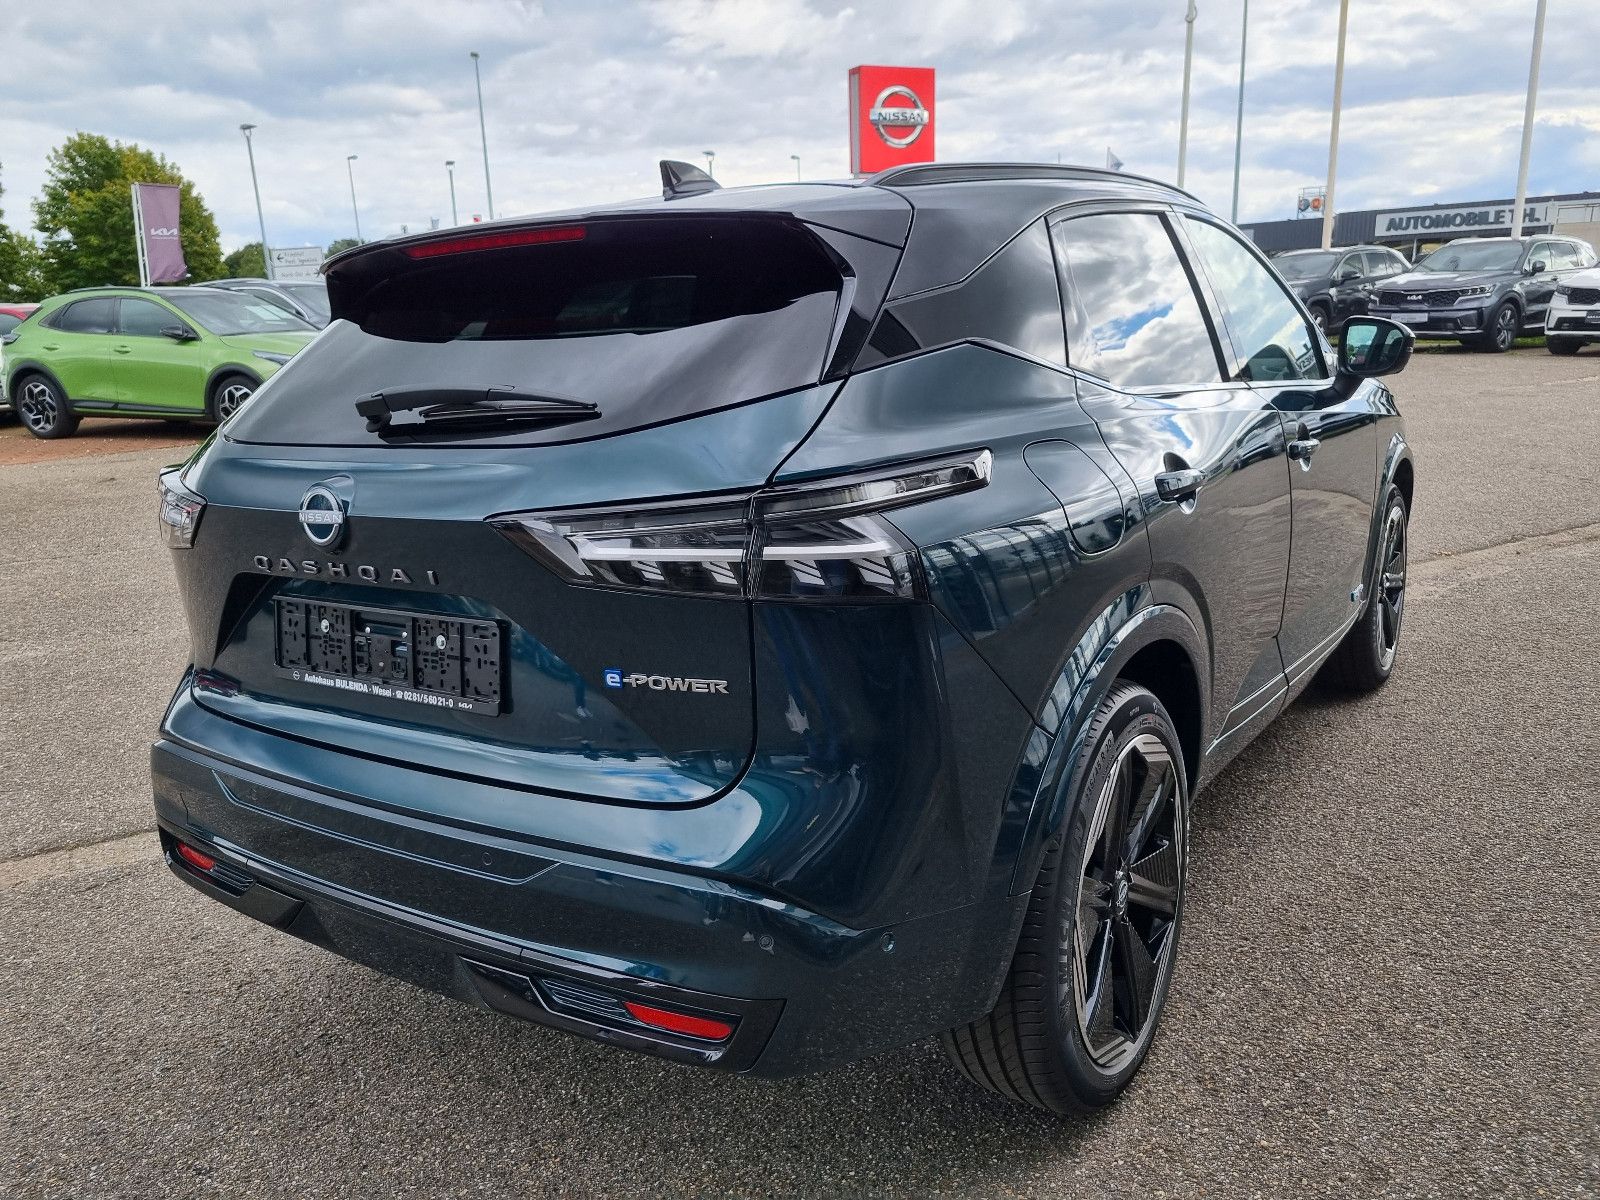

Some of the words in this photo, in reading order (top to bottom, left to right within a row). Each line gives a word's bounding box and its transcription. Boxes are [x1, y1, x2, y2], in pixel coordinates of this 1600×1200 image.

[877, 112, 923, 121] NISSAN
[1386, 210, 1505, 231] AUTOMOBILE
[299, 511, 342, 524] NISSAN
[253, 555, 440, 586] QASHQAI
[304, 673, 335, 687] Autohaus
[335, 678, 369, 693] BULENDA
[371, 685, 392, 698] Wesel
[605, 671, 729, 694] e-POWER
